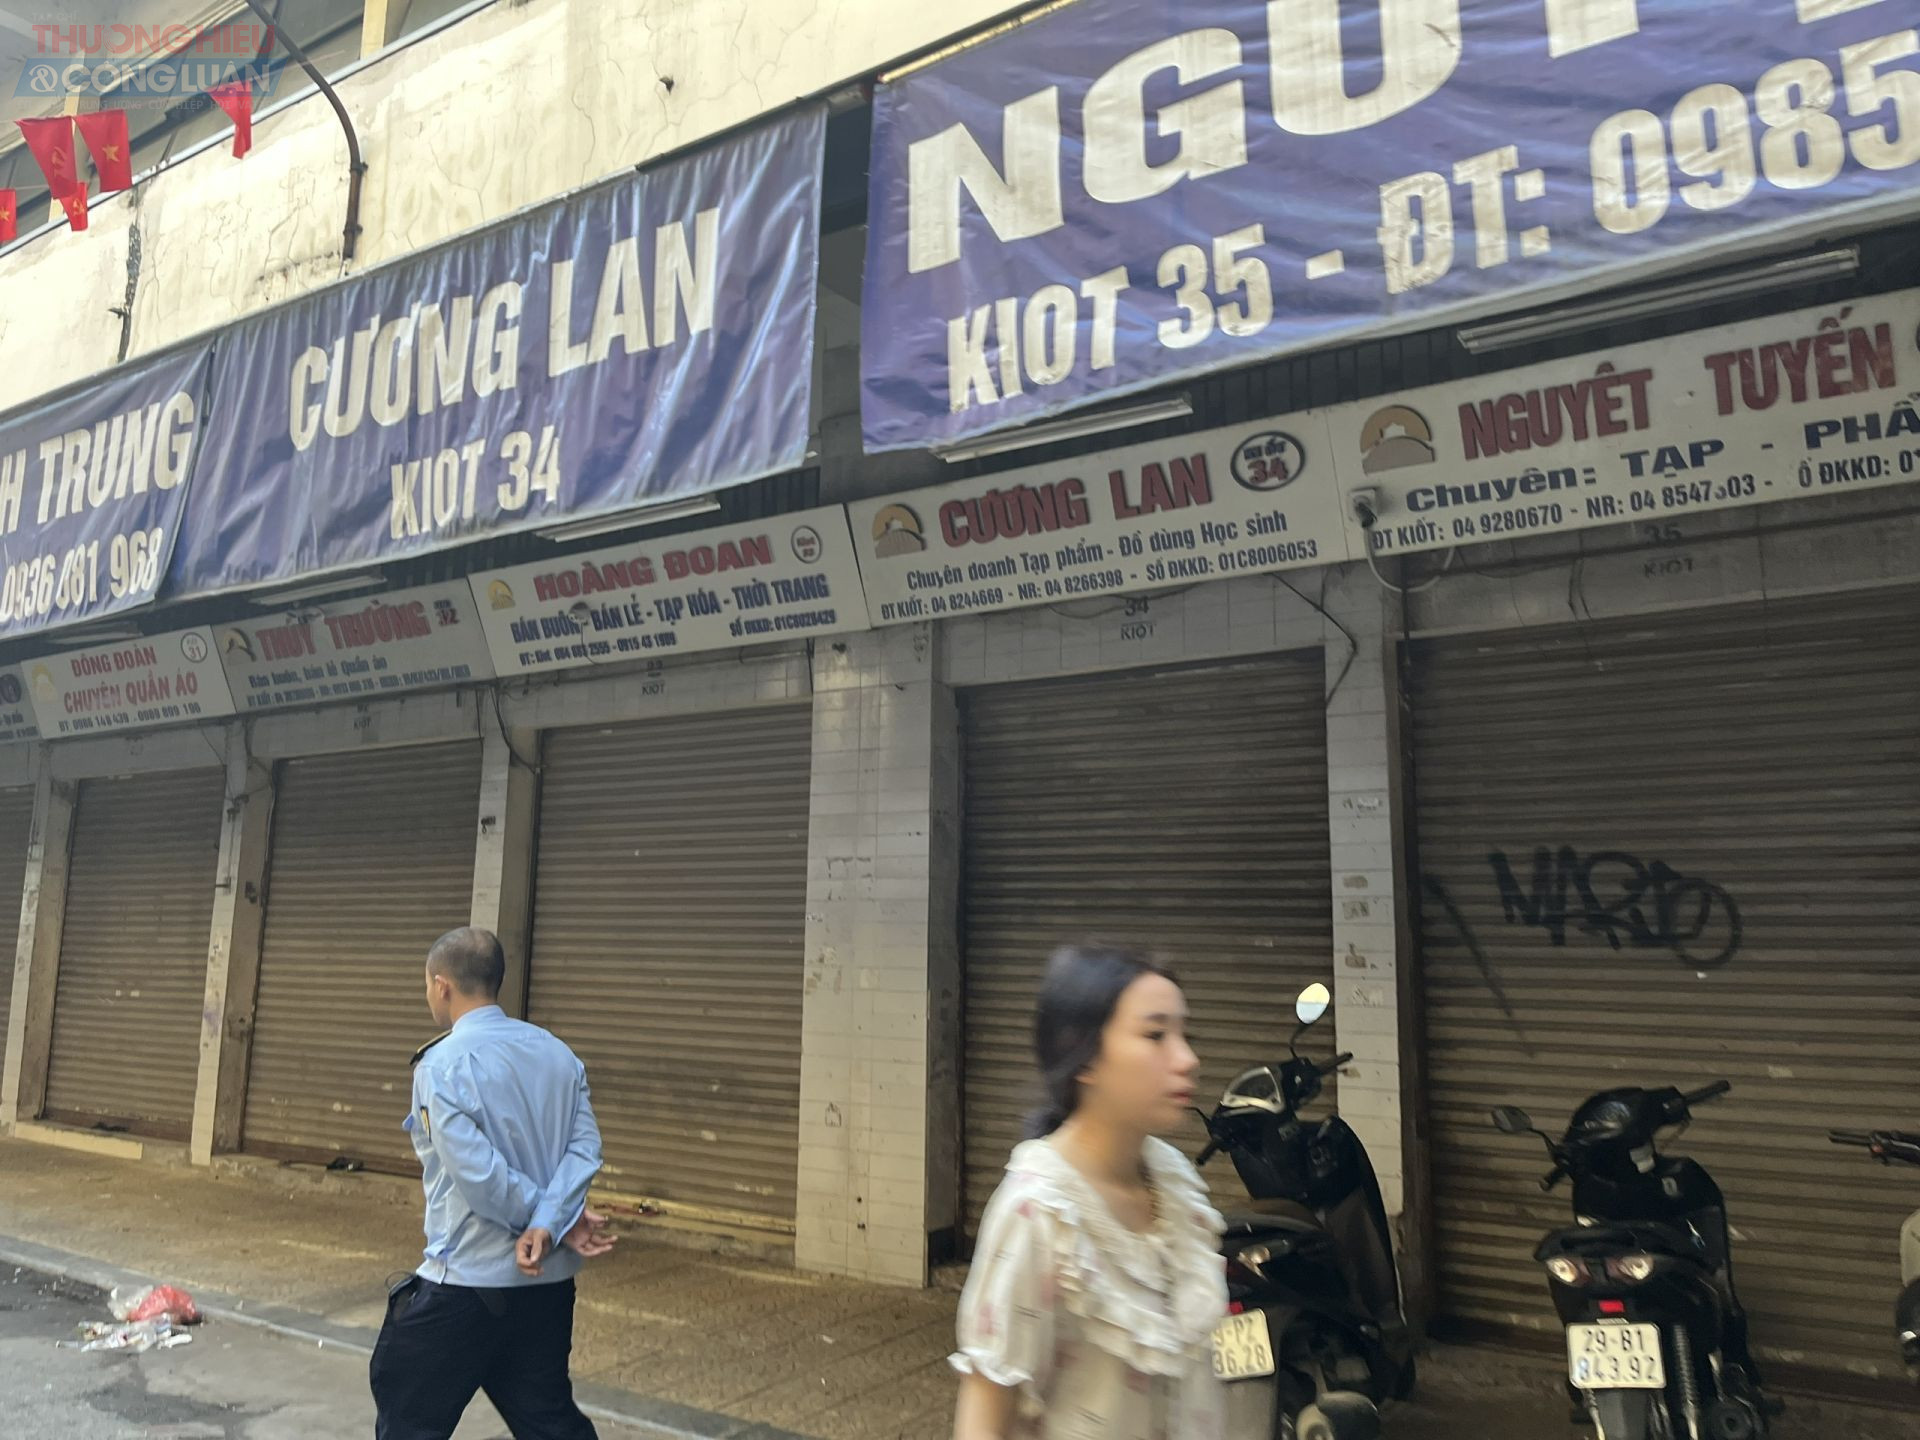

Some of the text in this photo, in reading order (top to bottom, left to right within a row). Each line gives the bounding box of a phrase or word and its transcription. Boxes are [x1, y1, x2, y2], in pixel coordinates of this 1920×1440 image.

[948, 265, 1130, 414] KIOT
[1157, 223, 1274, 350] 35
[1376, 145, 1551, 295] ĐT:
[290, 207, 719, 451] CƯƠNG LAN
[1704, 306, 1896, 417] TUYẾN
[37, 391, 194, 525] TRUNG
[391, 425, 561, 539] KIOT 34
[938, 453, 1213, 548] CƯƠNG LAN
[1247, 457, 1289, 484] 34
[1372, 527, 1393, 549] ĐT
[1453, 517, 1476, 538] 04
[1480, 503, 1562, 534] 9280670
[1586, 495, 1624, 519] NR:
[1630, 489, 1655, 512] 04
[1819, 454, 1891, 485] ĐKKD:
[1620, 439, 1724, 479] TẠP
[110, 527, 163, 599] 968
[533, 534, 774, 602] HOÀNG ĐOAN
[881, 602, 896, 620] ĐT
[931, 597, 947, 614] 04
[949, 587, 1004, 611] 8244669
[1017, 583, 1041, 600] NR:
[1045, 579, 1063, 597] 04
[1065, 569, 1123, 594] 8266398
[1146, 558, 1165, 582] SỐ
[1168, 556, 1214, 579] ĐKKD:
[1219, 539, 1318, 571] 01C8006053
[906, 563, 963, 591] Chuyên
[968, 555, 1017, 582] doanh
[1020, 550, 1050, 577] Tạp
[1056, 536, 1104, 571] phẩm
[1119, 530, 1143, 557] Đồ
[1150, 527, 1195, 552] dùng
[1200, 521, 1238, 546] Học
[1246, 510, 1287, 537] sinh
[510, 616, 540, 645] BÁN
[590, 603, 623, 633] BÁN
[624, 593, 645, 626] LẺ
[654, 596, 684, 627] TẠP
[732, 577, 770, 611] THỜI
[771, 573, 830, 606] TRANG
